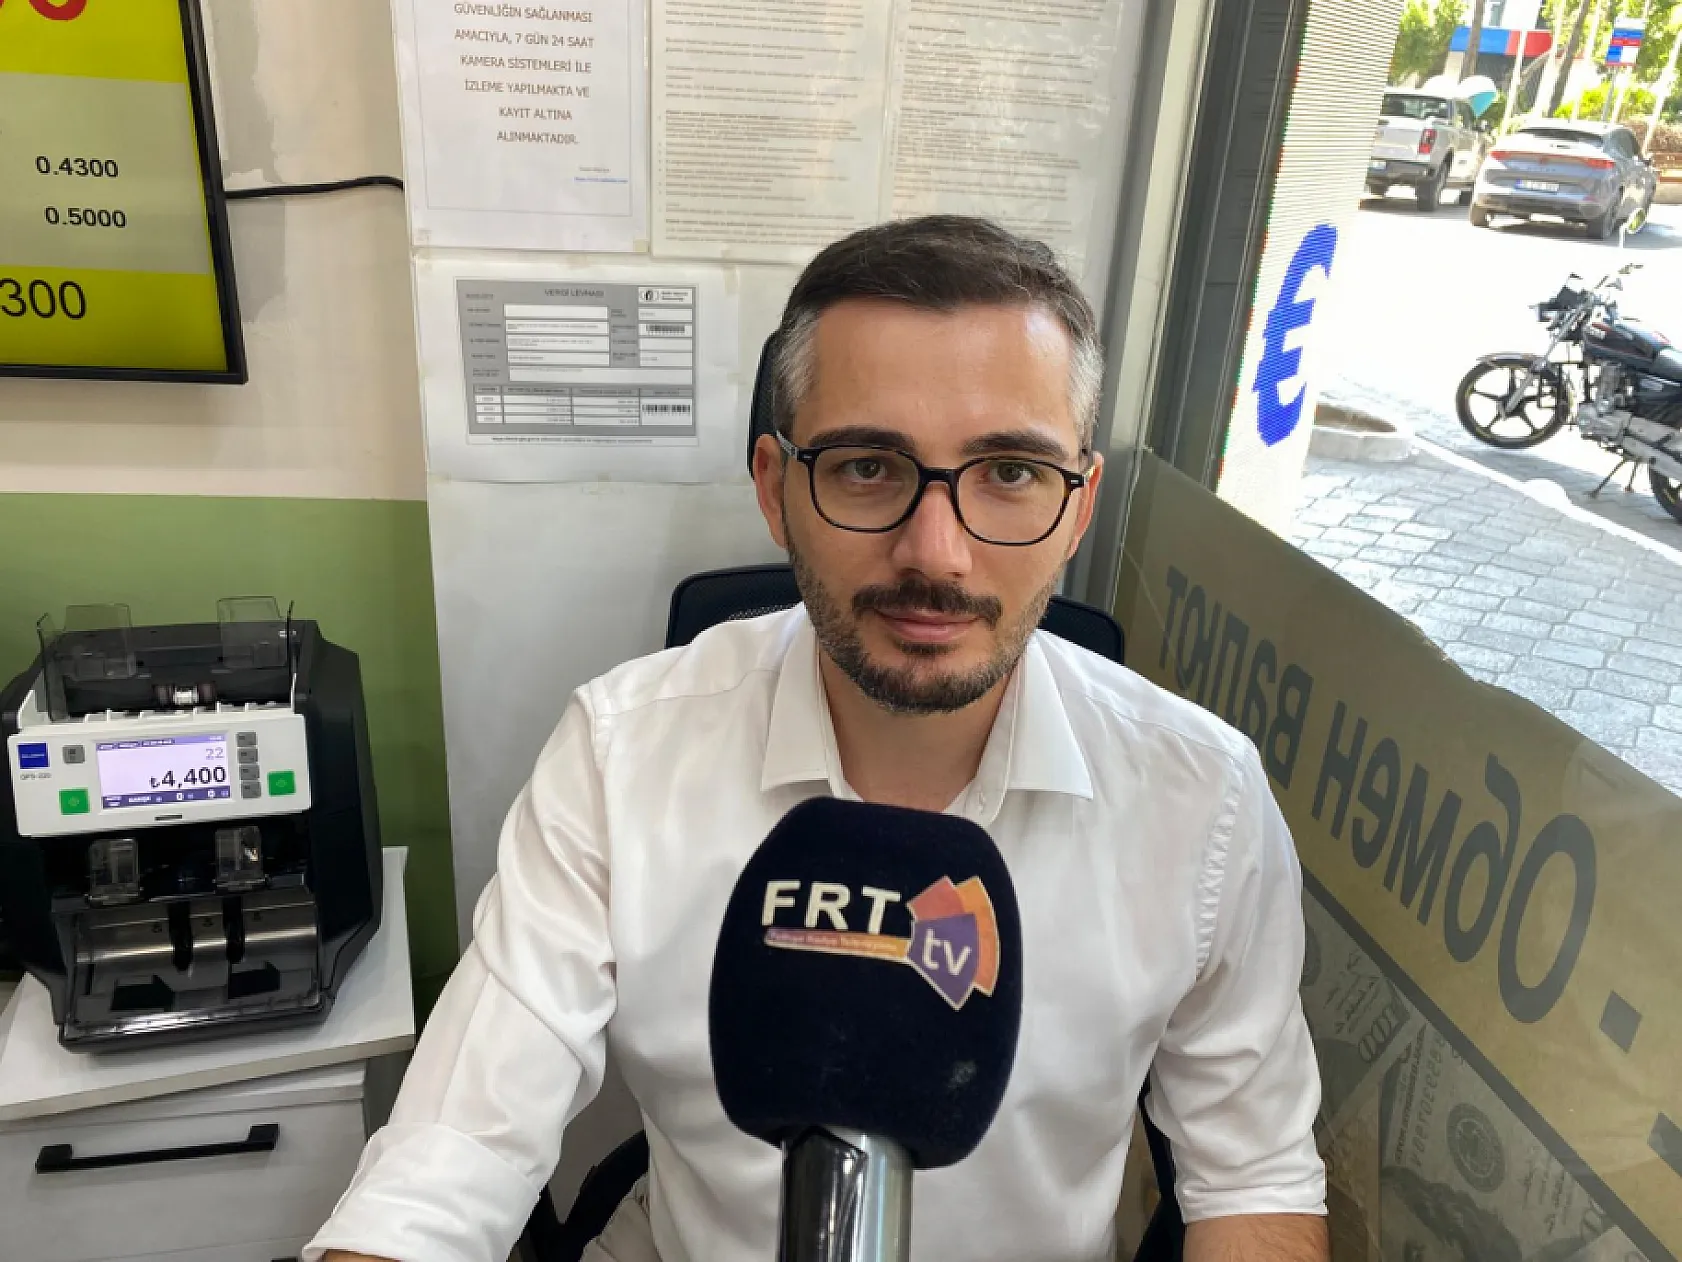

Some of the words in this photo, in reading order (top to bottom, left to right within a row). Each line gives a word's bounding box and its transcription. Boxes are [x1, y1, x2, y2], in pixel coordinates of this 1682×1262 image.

[524, 5, 593, 22] SAĞLANMASI
[454, 29, 512, 44] AMACIYLA,
[515, 32, 522, 44] 7
[525, 32, 549, 45] GÜN
[552, 35, 564, 47] 24
[567, 36, 594, 48] SAAT
[460, 55, 505, 68] KAMERA
[507, 57, 571, 72] SİSTEMLERİ
[575, 60, 592, 73] İLE
[465, 79, 504, 92] İZLEME
[507, 82, 573, 96] YAPILMAKTA
[575, 86, 590, 98] VE
[499, 107, 531, 119] KAYIT
[534, 108, 573, 121] ALTINA
[496, 131, 579, 144] ALINMAKTADIR.
[36, 155, 119, 178] 0.4300
[45, 206, 126, 228] 0.5000
[0, 278, 86, 320] 300
[205, 747, 225, 760] 22
[761, 879, 901, 935] FRT
[922, 928, 972, 976] tv
